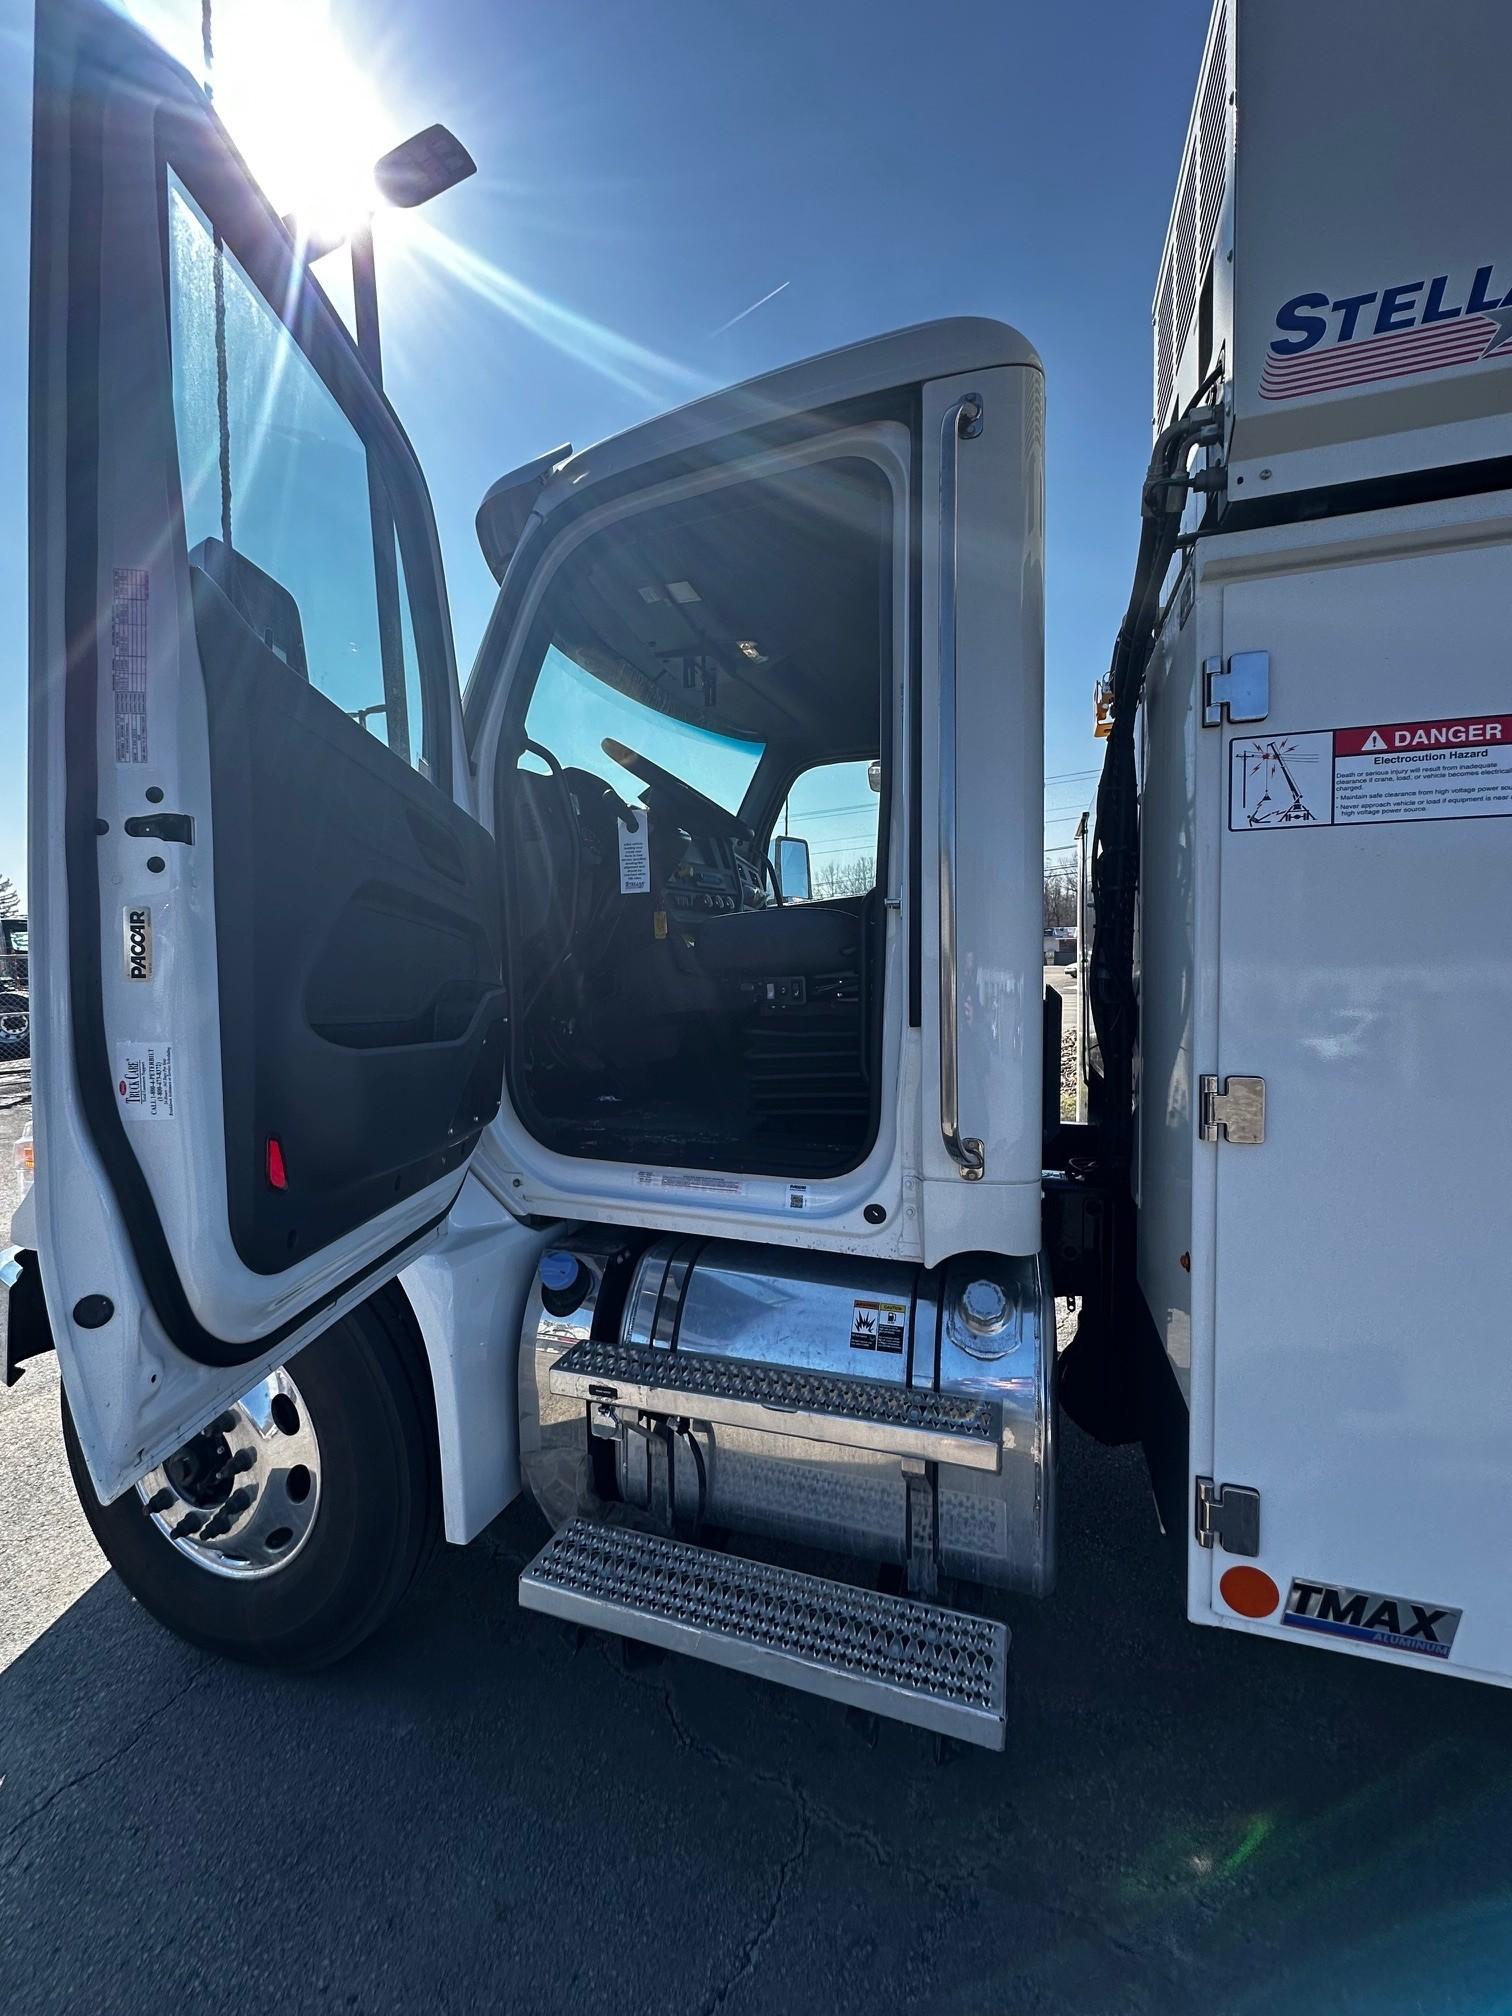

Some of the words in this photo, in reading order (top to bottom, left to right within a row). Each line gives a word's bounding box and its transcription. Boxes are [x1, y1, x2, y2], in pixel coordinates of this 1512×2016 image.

[1394, 723, 1502, 747] DANGER
[1373, 752, 1446, 765] Electrocution
[1449, 749, 1489, 760] Hazard
[1336, 771, 1356, 779] Death
[1390, 768, 1409, 776] injury
[1459, 762, 1498, 770] inadequate
[1336, 777, 1367, 785] clearance
[1448, 770, 1479, 778] becomes
[1384, 790, 1417, 798] clearance
[1434, 787, 1450, 795] high
[1451, 786, 1476, 794] voltage
[1477, 785, 1499, 793] power
[1361, 801, 1392, 809] approach
[1393, 799, 1416, 807] vehicle
[1448, 795, 1484, 804] equipment
[1356, 808, 1381, 816] voltage
[1381, 807, 1403, 815] power
[129, 911, 147, 979] PACCAR
[124, 1080, 141, 1104] TRUCK
[150, 1100, 158, 1116] CALL
[1293, 1582, 1450, 1642] TMAX
[1372, 1632, 1449, 1656] ALUMINUM
